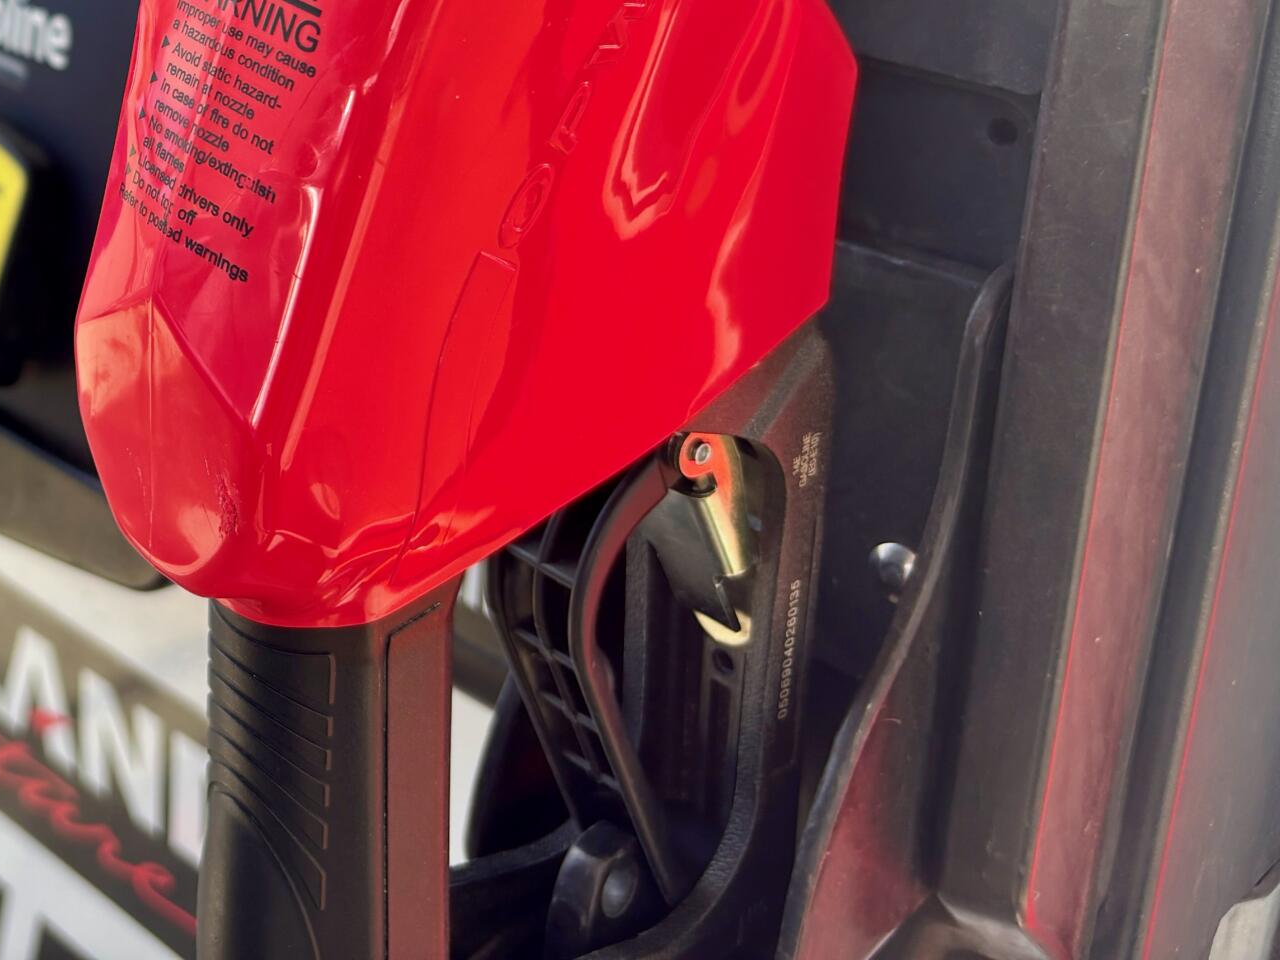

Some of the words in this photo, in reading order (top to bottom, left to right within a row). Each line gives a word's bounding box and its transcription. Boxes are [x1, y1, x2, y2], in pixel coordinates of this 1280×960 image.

[172, 42, 202, 67] Avoid
[202, 59, 231, 84] static
[234, 75, 282, 110] hazard-
[173, 19, 180, 30] a
[181, 20, 235, 59] hazardous
[238, 53, 295, 91] condition
[222, 22, 244, 41] use
[246, 33, 272, 58] may
[275, 50, 317, 78] cause
[160, 78, 170, 93] In
[172, 89, 194, 109] case
[197, 100, 208, 115] of
[209, 108, 229, 129] fire
[232, 122, 248, 140] do
[251, 134, 275, 155] not
[166, 62, 199, 88] remain
[201, 81, 212, 96] at
[214, 91, 255, 121] nozzle
[148, 115, 162, 134] No
[154, 99, 190, 129] remove
[191, 122, 230, 153] nozzle
[143, 136, 154, 150] all
[156, 141, 185, 173] flames
[132, 170, 145, 190] Do
[146, 184, 161, 203] not
[177, 207, 198, 226] off
[137, 153, 177, 189] Licensed
[178, 183, 220, 217] drivers
[222, 210, 254, 238] only
[120, 182, 139, 208] Refer
[139, 201, 148, 217] to
[185, 236, 249, 283] warnings
